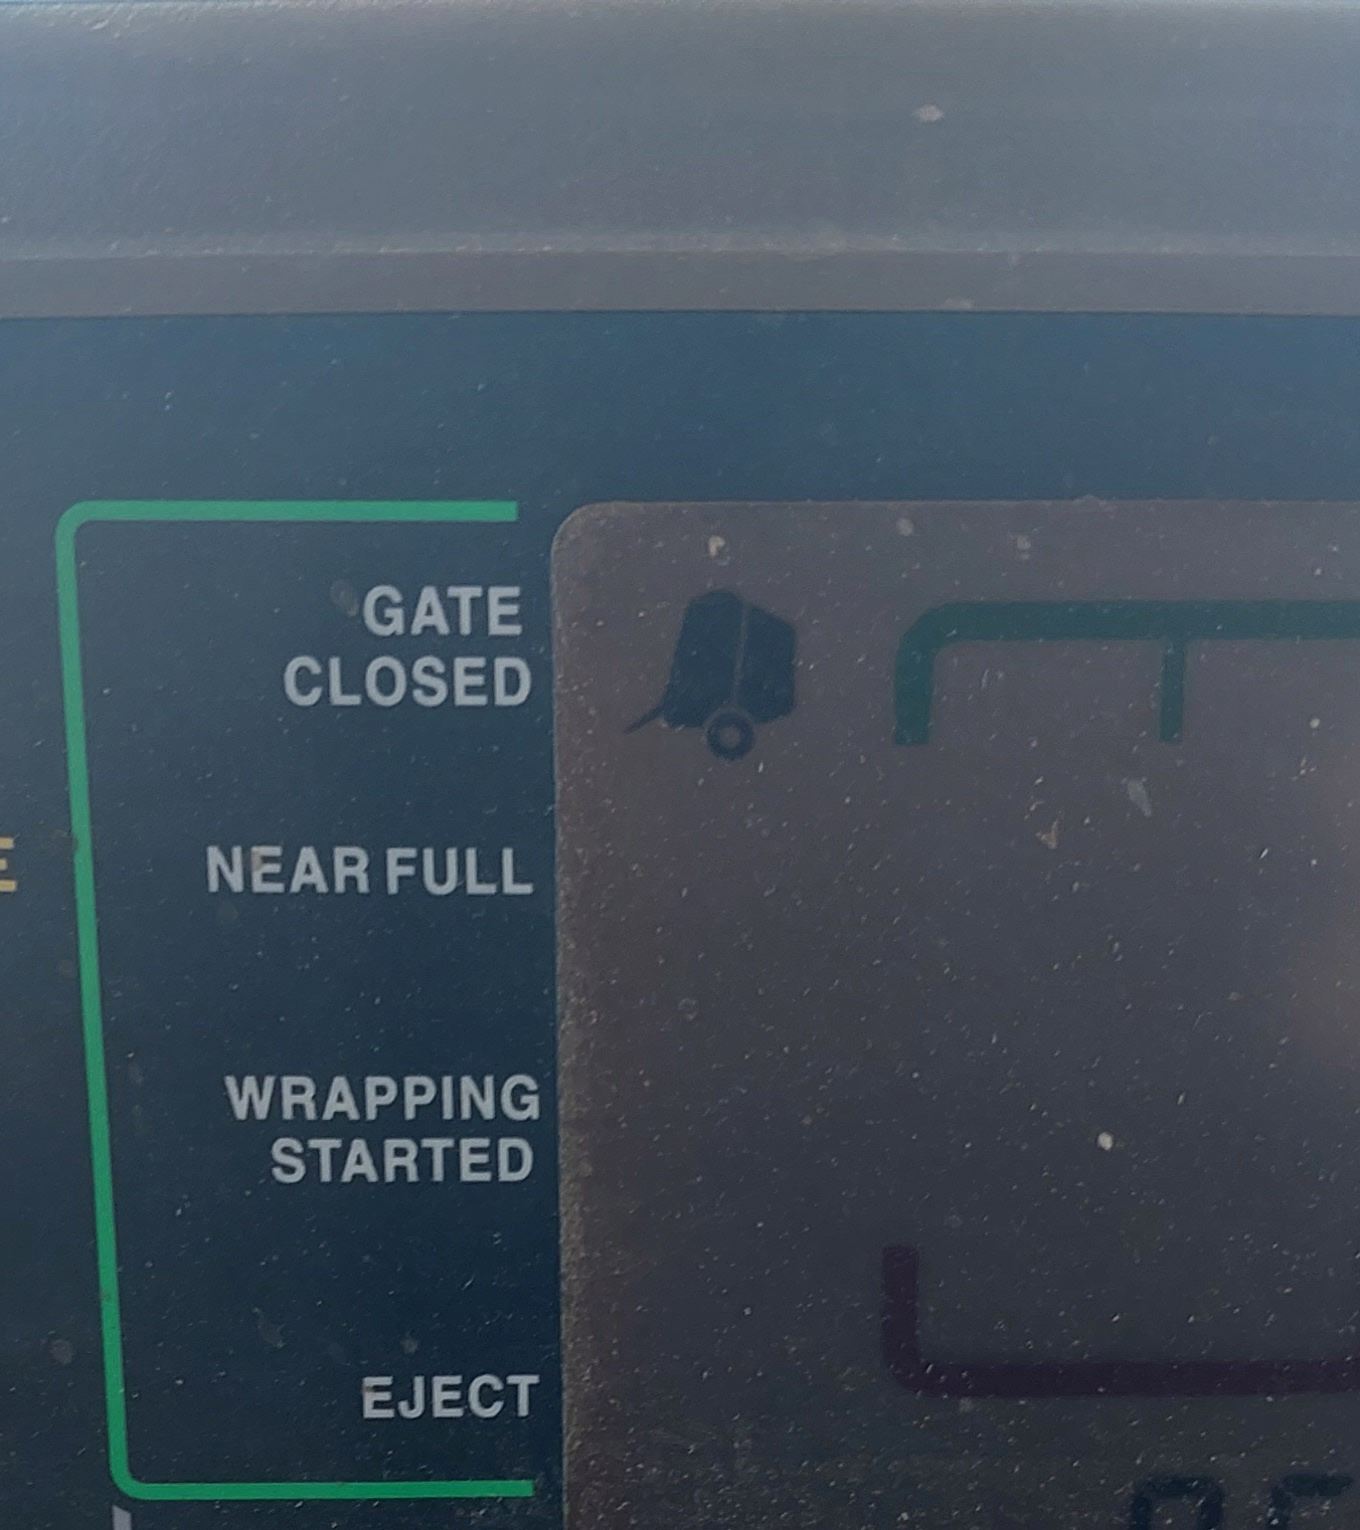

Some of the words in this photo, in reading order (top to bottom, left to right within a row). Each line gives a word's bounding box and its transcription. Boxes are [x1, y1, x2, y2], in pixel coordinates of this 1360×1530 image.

[362, 583, 523, 637] GATE
[282, 654, 533, 708] CLOSED
[205, 844, 370, 894] NEAR
[385, 846, 535, 896] FULL
[223, 1073, 541, 1122] WRAPPING
[270, 1136, 534, 1185] STARTED
[362, 1372, 541, 1420] EJECT
